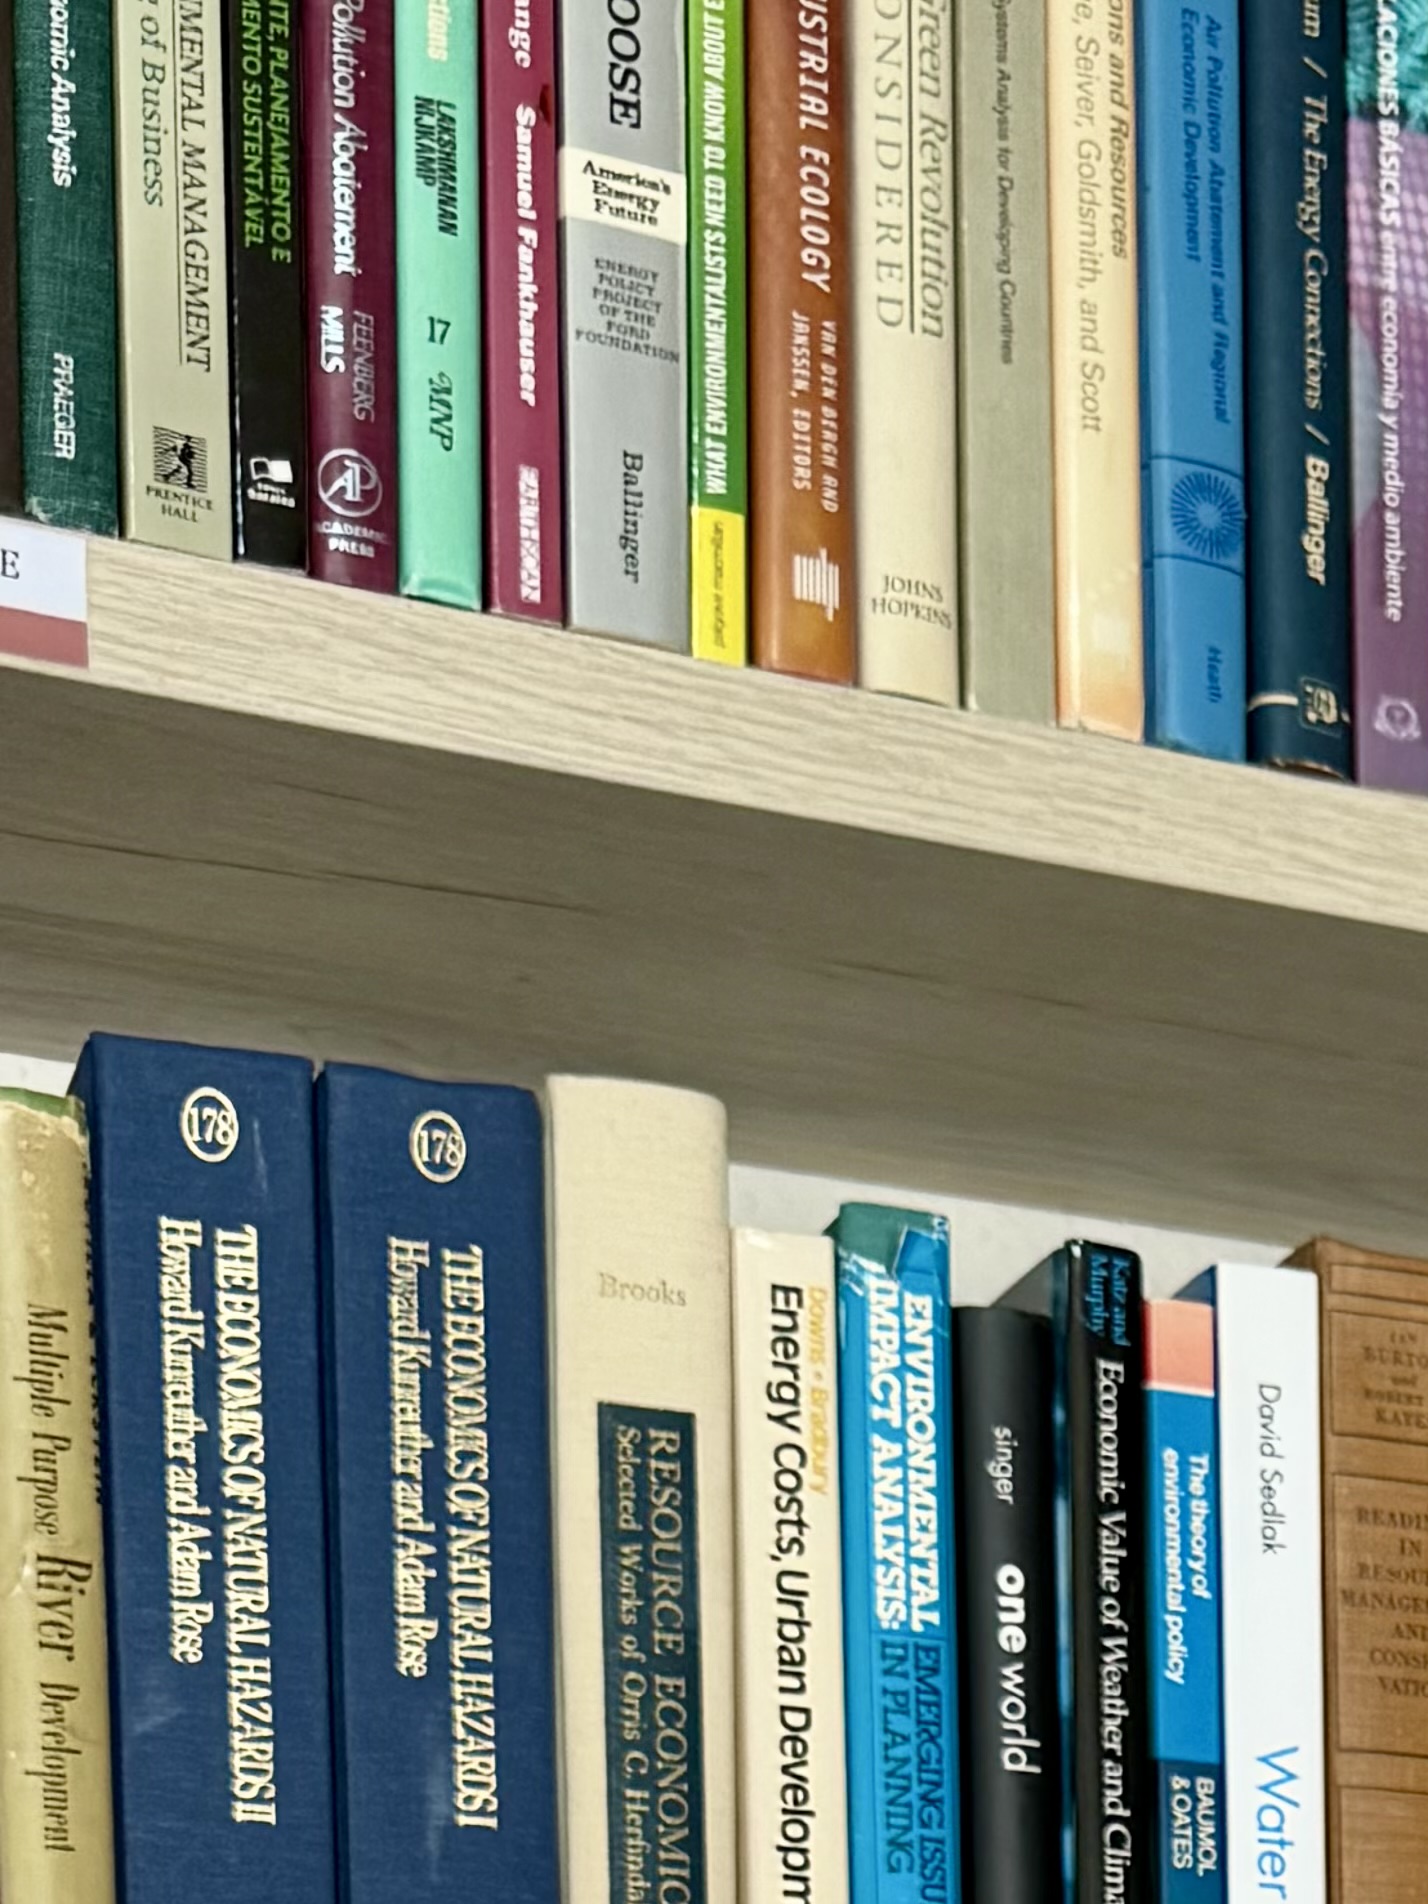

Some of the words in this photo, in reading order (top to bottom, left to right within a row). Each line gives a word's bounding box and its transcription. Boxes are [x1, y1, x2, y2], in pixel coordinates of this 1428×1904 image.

[513, 104, 538, 224] Samuel
[319, 304, 346, 375] MILLS
[427, 317, 451, 346] 17
[514, 227, 538, 408] Fankhauser
[52, 351, 76, 462] PRAEGER
[621, 450, 645, 583] Ballinger
[1302, 455, 1330, 586] Ballinger
[188, 1107, 232, 1146] 178
[418, 1128, 463, 1167] 178
[597, 1273, 687, 1307] Brooks
[767, 1285, 804, 1435] Energy
[904, 1291, 942, 1631] ENVIRONMENTAL
[983, 1426, 1014, 1505] singer
[1257, 1384, 1282, 1457] David
[647, 1428, 685, 1653] RESOURCE
[771, 1442, 809, 1560] Costs,
[872, 1436, 902, 1630] ANALYSIS:
[1260, 1466, 1286, 1555] Sedlak
[776, 1573, 811, 1696] Urban
[997, 1565, 1026, 1653] one
[998, 1663, 1041, 1775] world
[1256, 1746, 1300, 1899] Water
